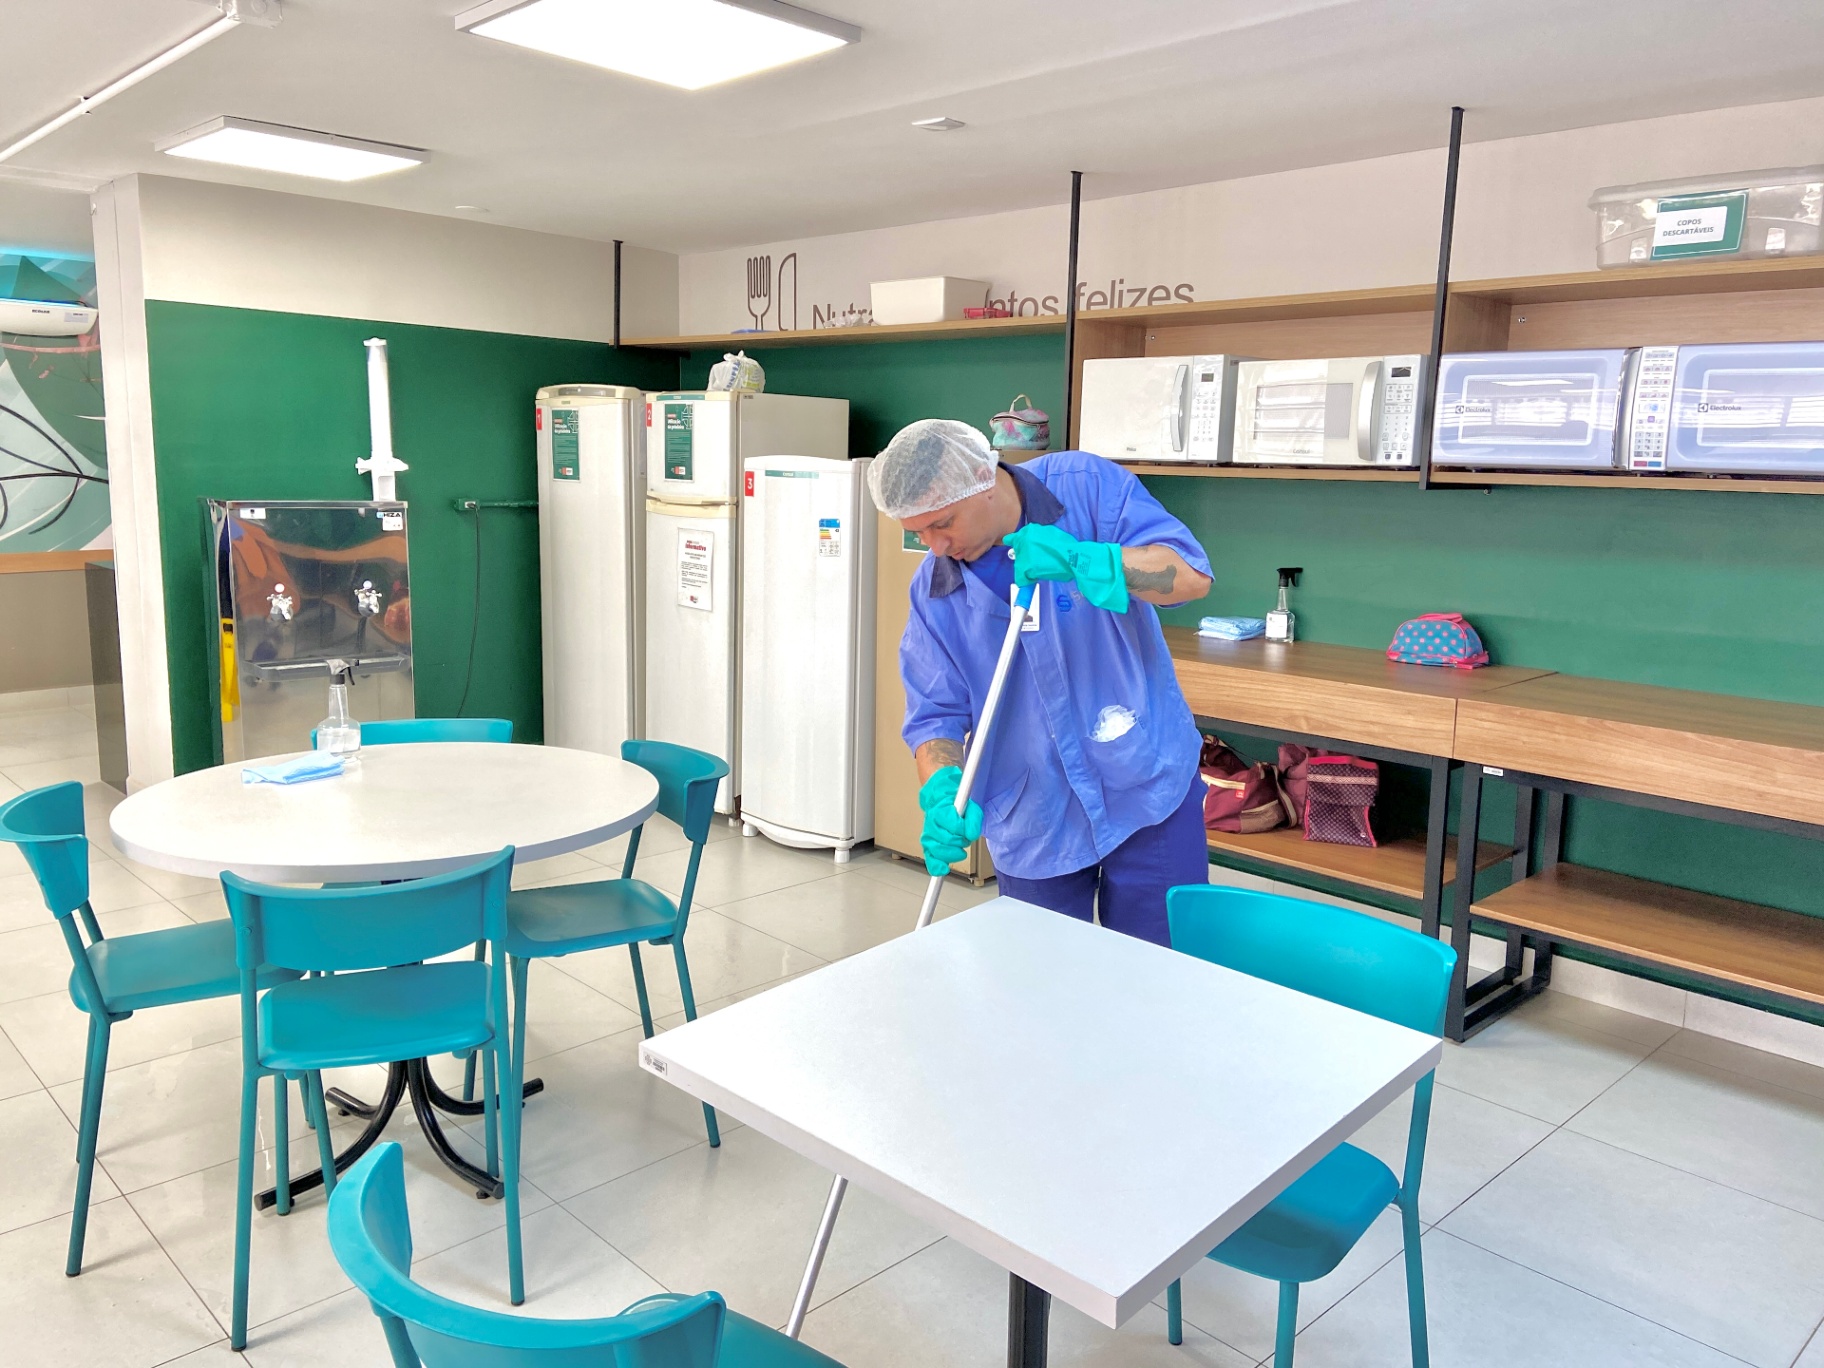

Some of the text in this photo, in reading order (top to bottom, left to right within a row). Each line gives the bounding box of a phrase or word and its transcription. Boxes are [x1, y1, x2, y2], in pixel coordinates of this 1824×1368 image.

[1677, 218, 1702, 226] COPOS
[1662, 226, 1714, 236] DESCARTÁVEIS
[989, 289, 1060, 318] ntos
[1076, 278, 1195, 312] felizes
[647, 408, 652, 420] 2
[747, 478, 753, 490] 3
